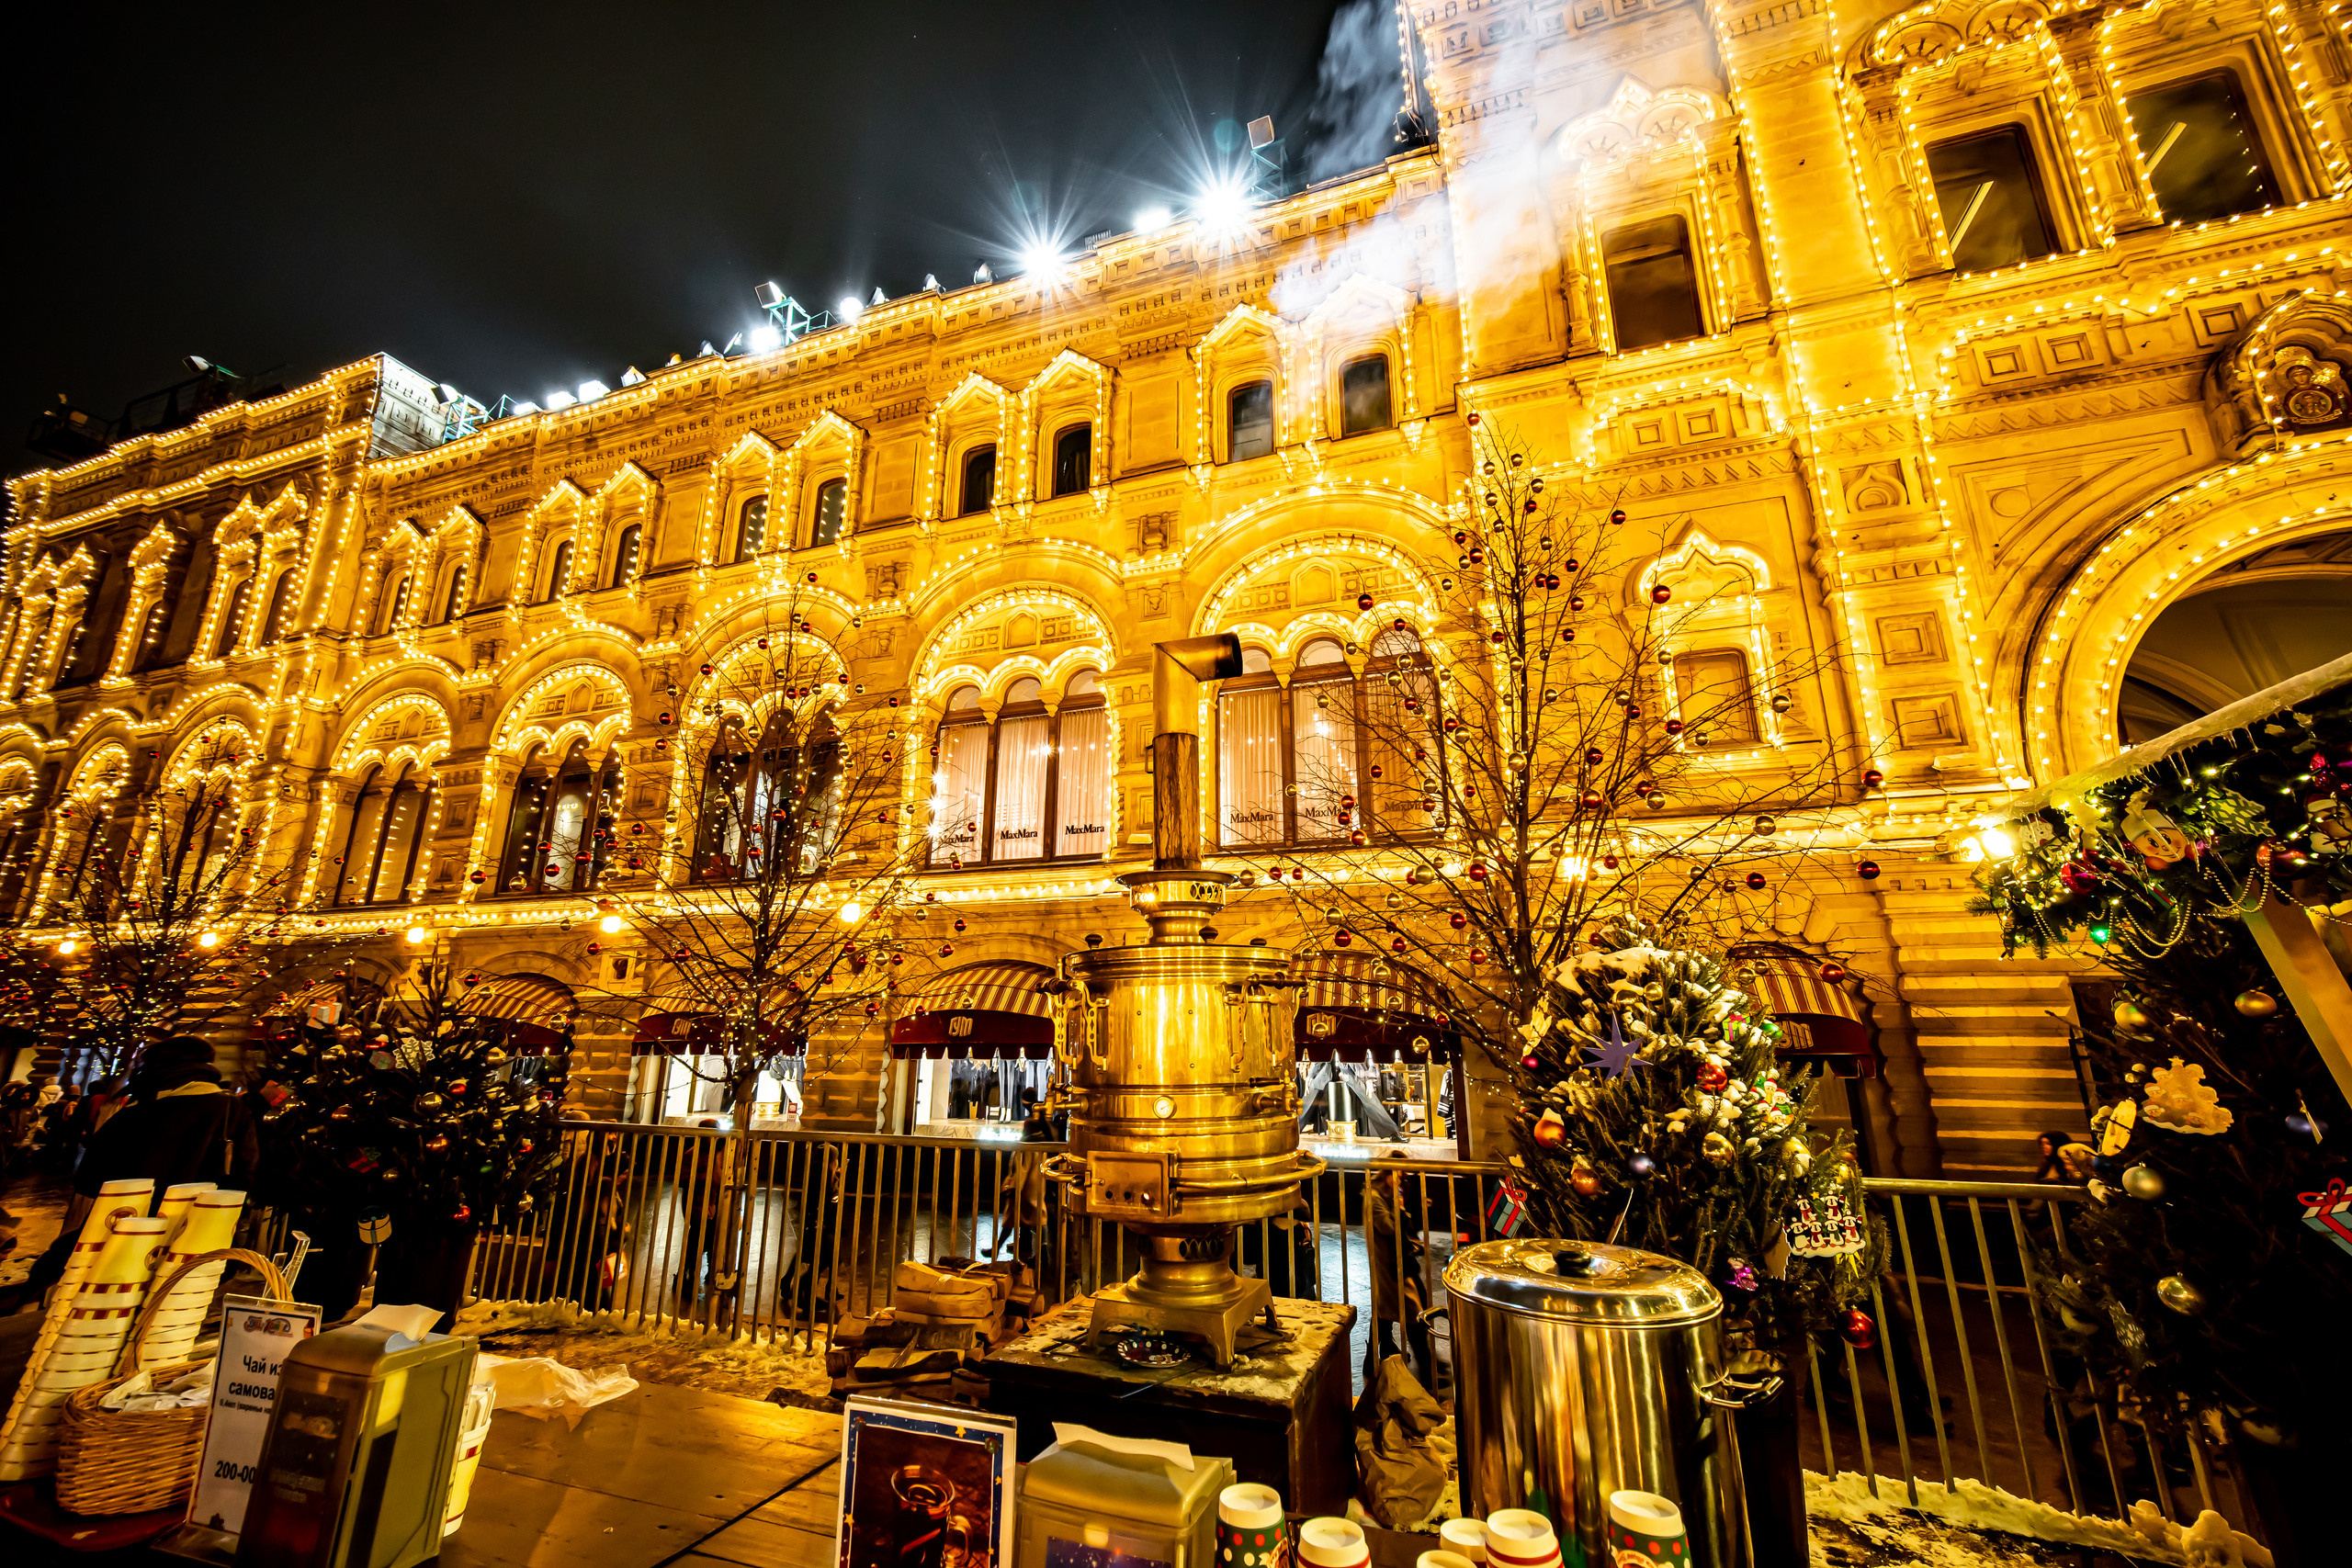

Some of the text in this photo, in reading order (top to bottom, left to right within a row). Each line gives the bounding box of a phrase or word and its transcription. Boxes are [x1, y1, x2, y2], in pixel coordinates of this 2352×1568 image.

[1229, 811, 1273, 823] MaxMara
[1306, 805, 1344, 818] MaxM
[1000, 829, 1038, 840] MaxMara
[1065, 824, 1104, 835] MaxMara
[243, 1354, 266, 1374] Чай
[229, 1382, 275, 1401] самова
